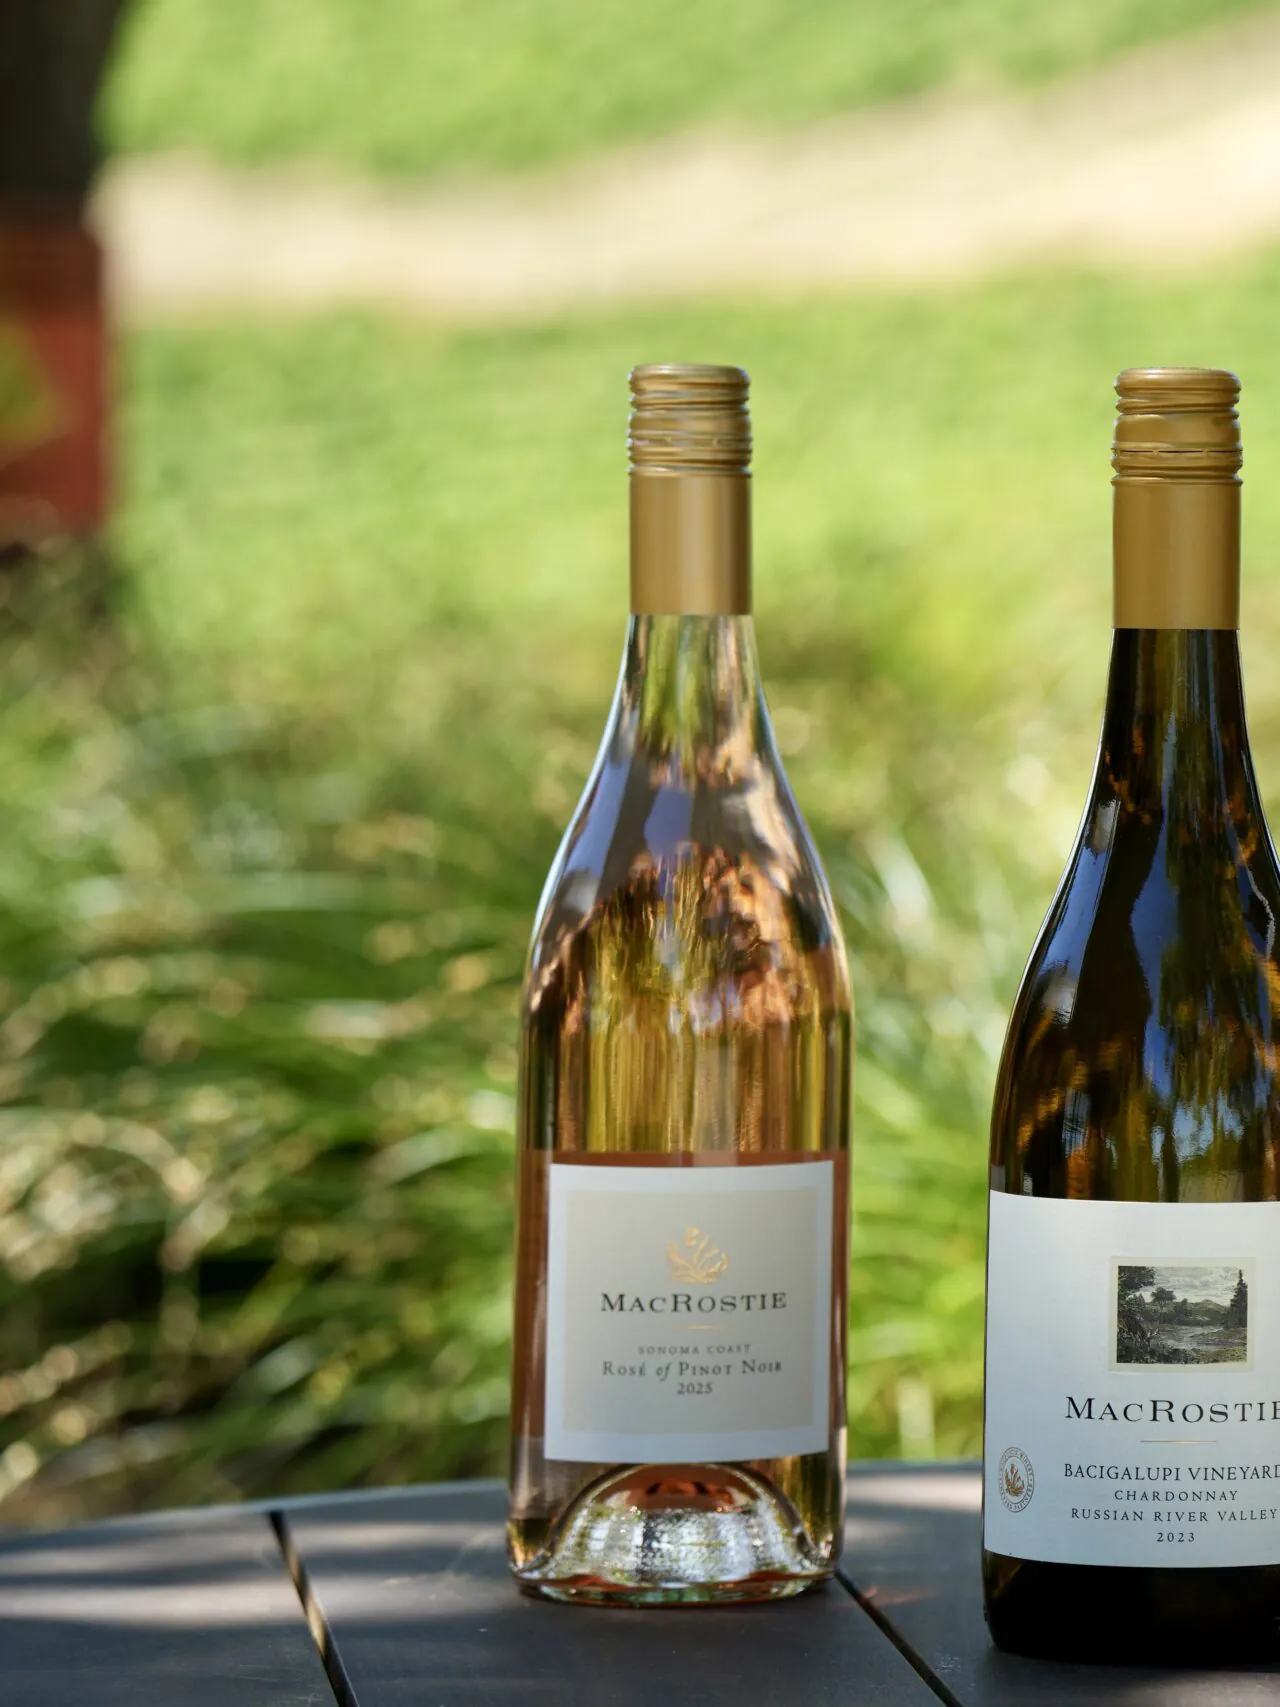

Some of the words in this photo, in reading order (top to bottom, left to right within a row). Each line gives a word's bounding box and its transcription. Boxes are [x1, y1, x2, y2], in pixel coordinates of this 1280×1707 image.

[637, 1345, 701, 1356] SONOMA
[706, 1343, 752, 1355] COAST
[655, 1361, 673, 1382] of
[678, 1361, 732, 1376] PINOT
[741, 1359, 783, 1375] NOIR
[676, 1381, 714, 1396] 2025
[1063, 1463, 1181, 1482] BACIGALUPI
[1113, 1489, 1239, 1502] CHARDONNAY
[1070, 1507, 1145, 1522] RUSSIAN
[1153, 1511, 1209, 1523] RIVER
[1218, 1508, 1279, 1522] VALLEY
[1156, 1531, 1196, 1543] 2023
